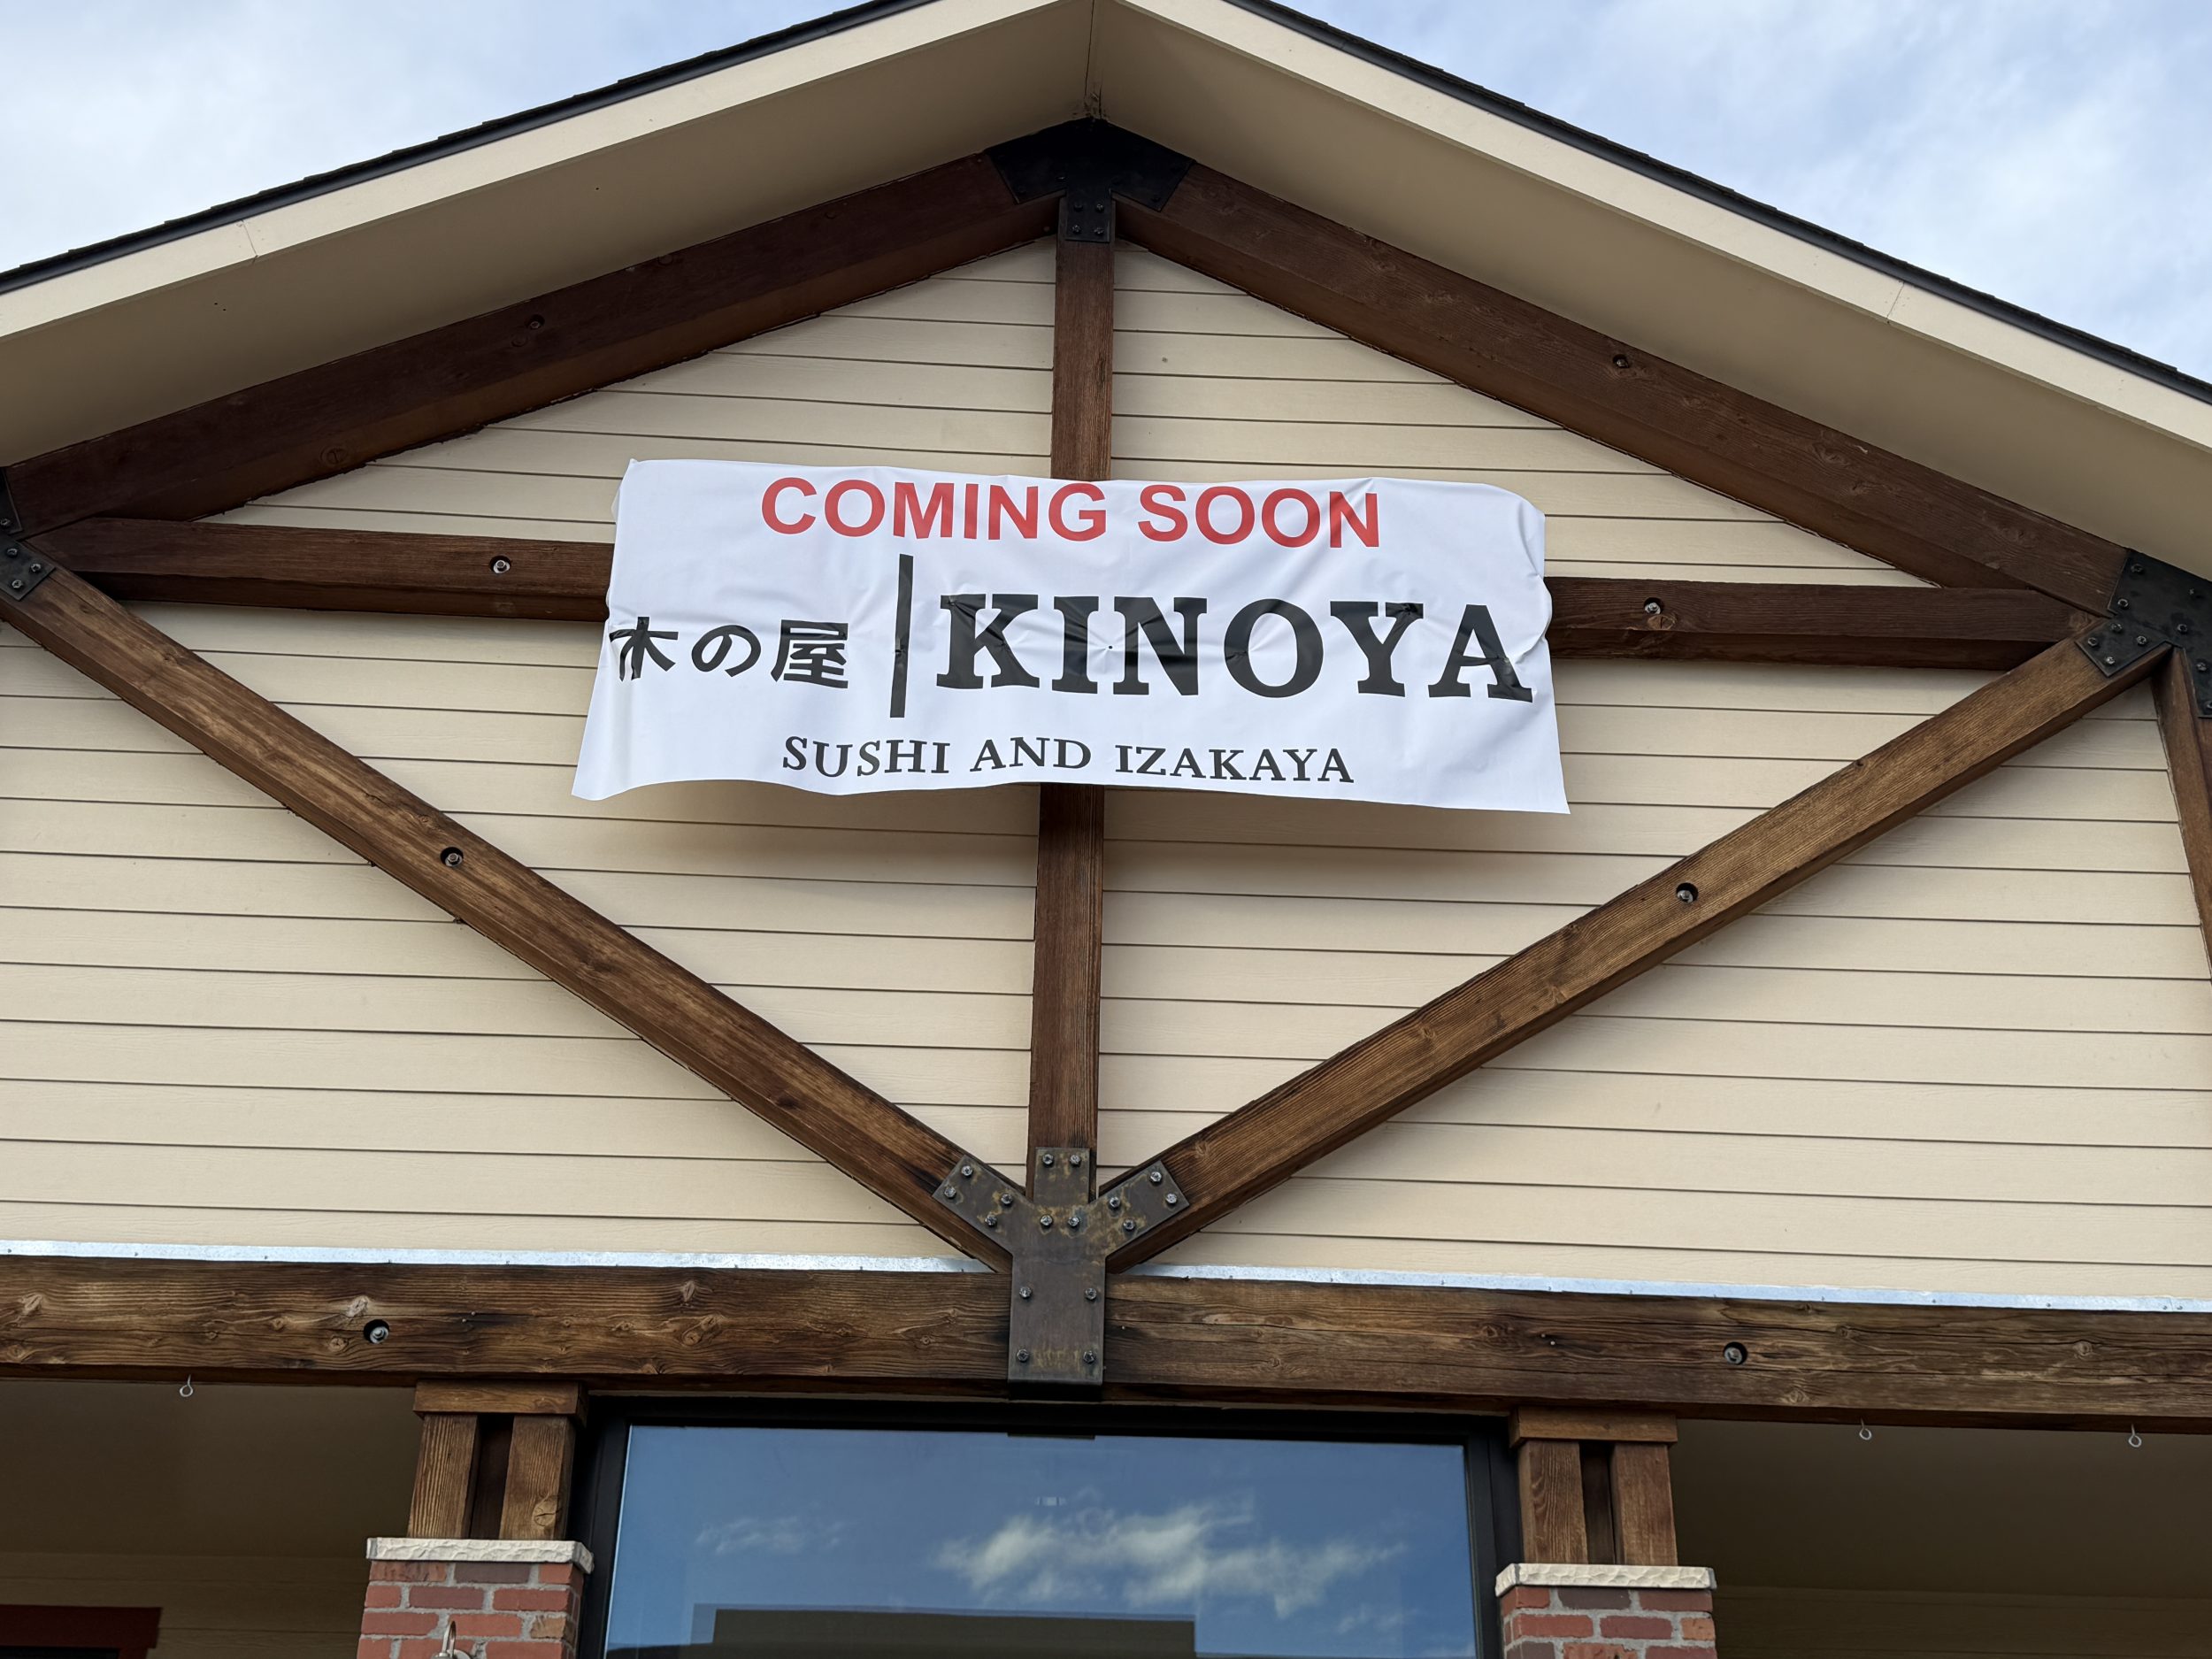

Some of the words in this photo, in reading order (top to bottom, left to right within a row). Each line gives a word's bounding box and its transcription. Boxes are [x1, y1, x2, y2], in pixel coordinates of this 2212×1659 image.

[761, 477, 1107, 541] COMING
[1138, 484, 1380, 548] SOON
[608, 616, 849, 689] 木の屋
[935, 593, 1534, 703] KINOYA
[781, 735, 951, 778] SUSHI
[969, 735, 1092, 773] AND
[1114, 745, 1356, 783] IZAKAYA
